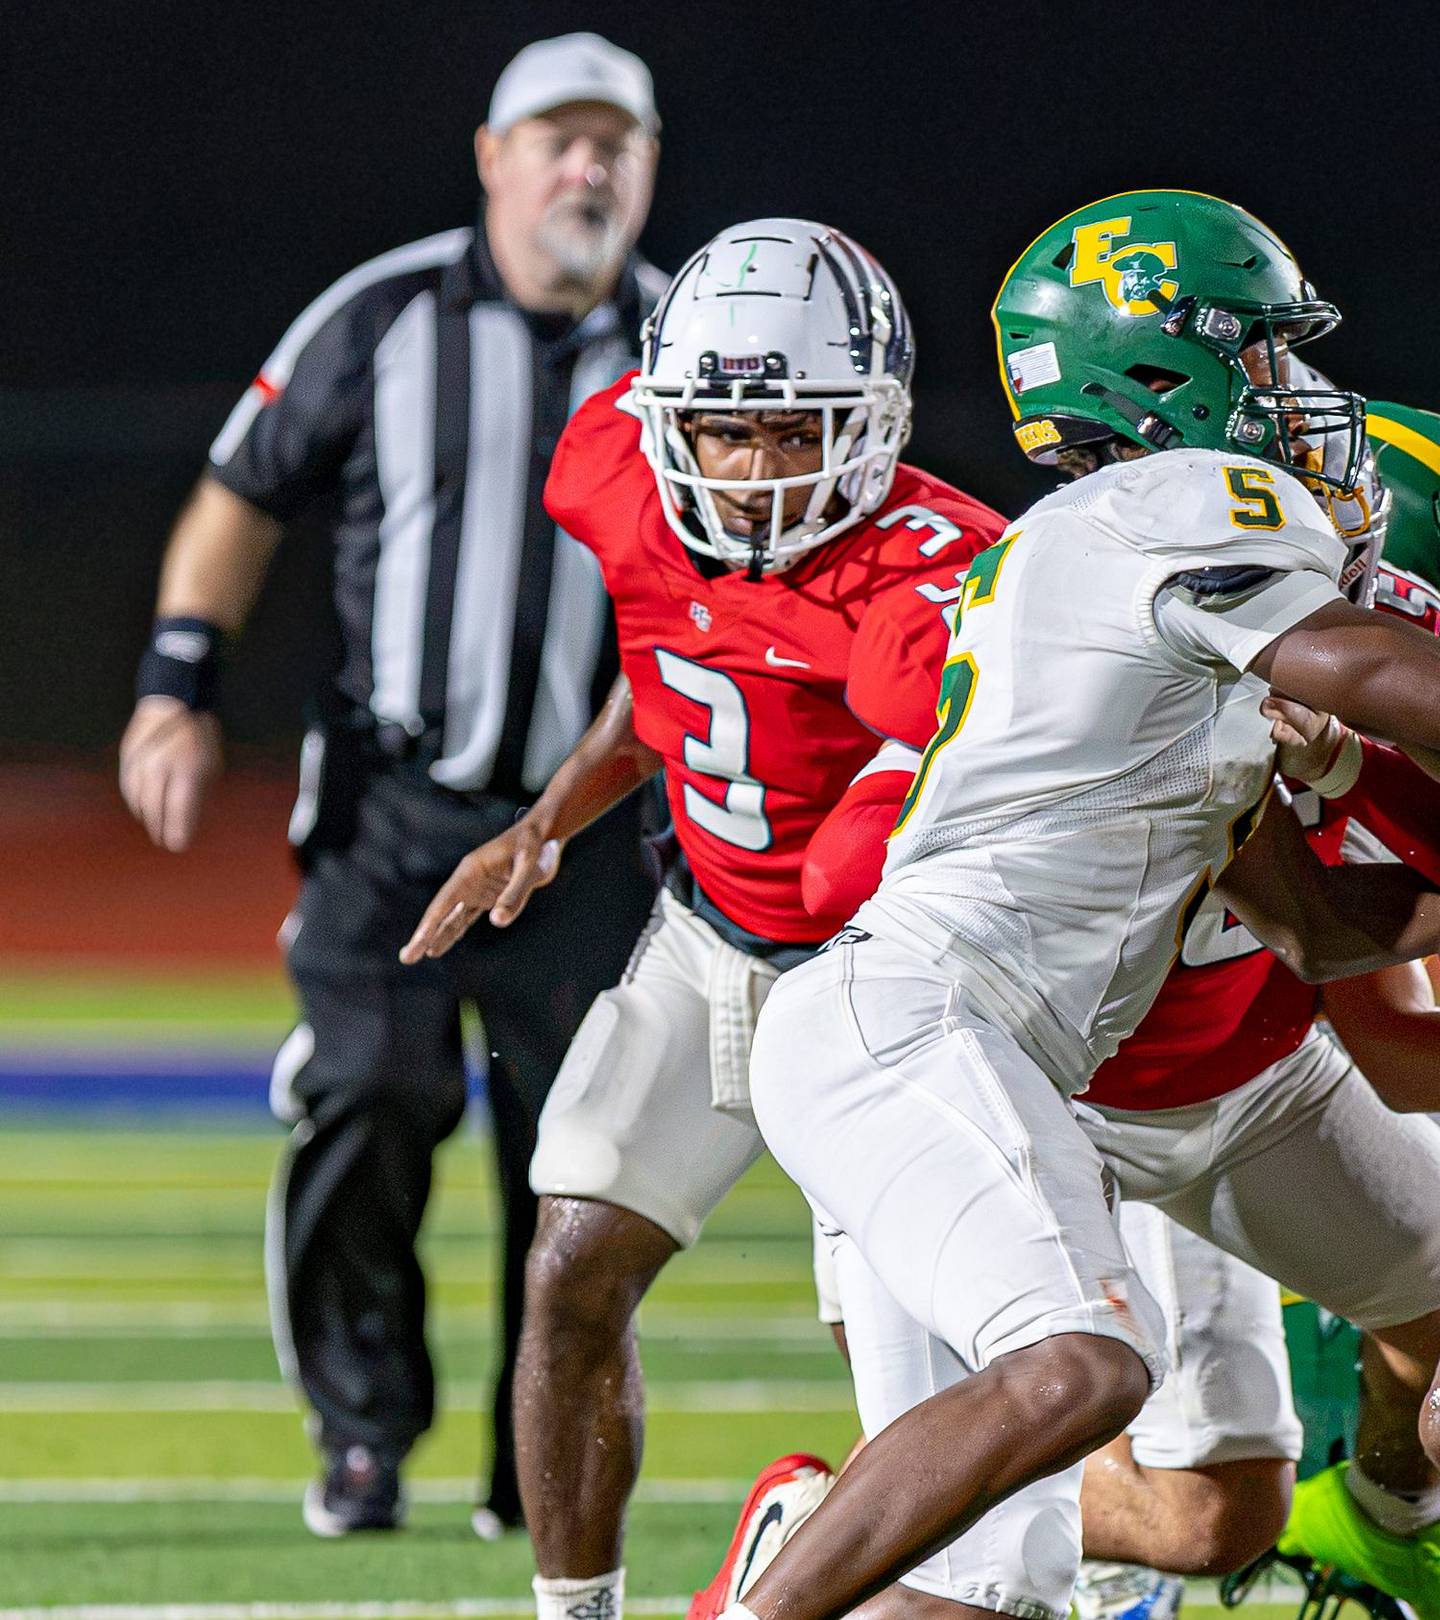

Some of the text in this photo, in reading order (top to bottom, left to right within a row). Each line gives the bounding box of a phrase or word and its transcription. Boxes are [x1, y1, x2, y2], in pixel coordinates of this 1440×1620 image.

[1069, 216, 1180, 318] EC
[875, 502, 963, 559] 3
[1222, 465, 1287, 532] 5
[1340, 559, 1367, 591] dell
[653, 645, 774, 853] 3
